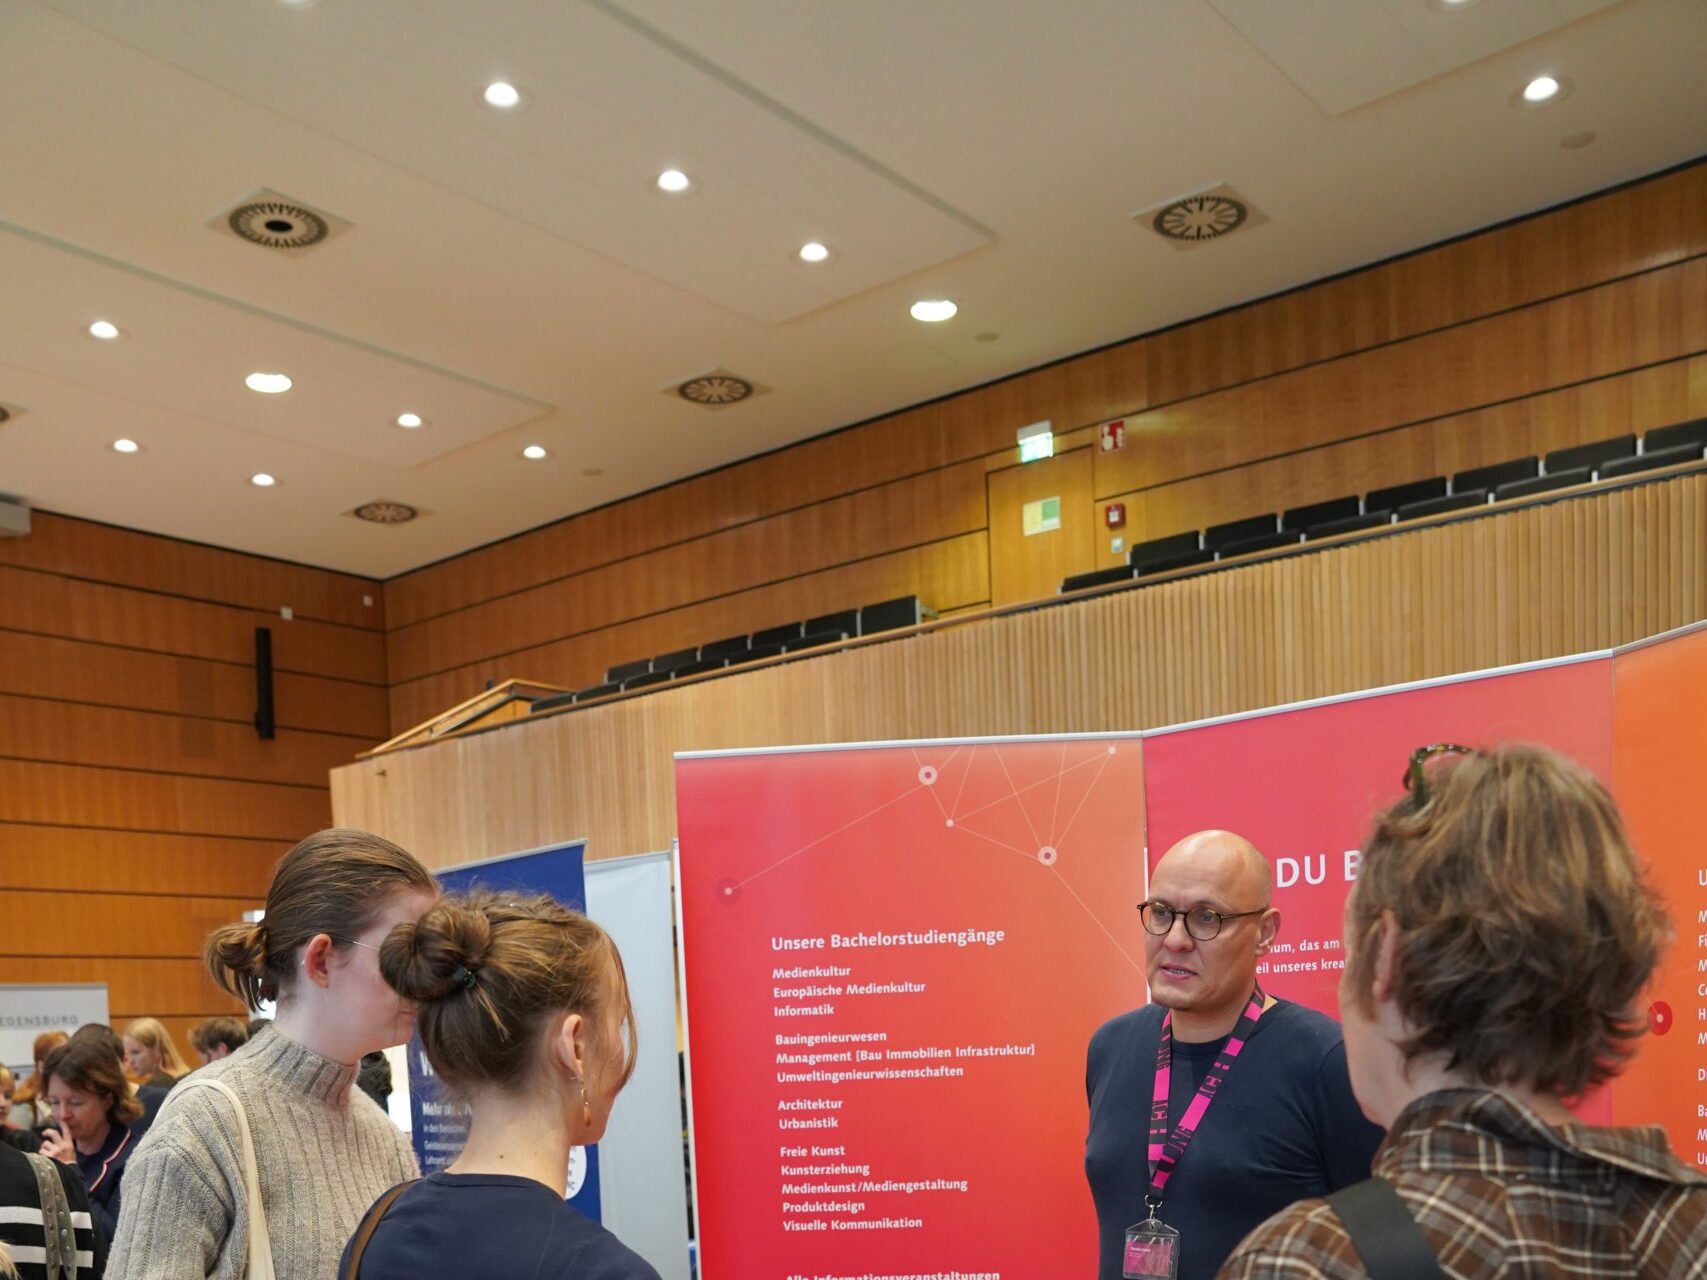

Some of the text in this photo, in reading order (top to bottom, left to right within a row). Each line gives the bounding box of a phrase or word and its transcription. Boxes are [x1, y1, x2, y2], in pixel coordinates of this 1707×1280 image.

[1277, 854, 1325, 887] DU
[772, 929, 1004, 950] Unsere Bachelorstudiengänge
[1300, 940, 1319, 951] das
[1323, 940, 1339, 949] am
[773, 966, 851, 978] Medienkultur
[1274, 962, 1317, 972] unseres
[774, 982, 926, 999] Europäische Medienkultur
[775, 1004, 834, 1016] Informatik
[776, 1032, 886, 1047] Bauingenieurwesen
[776, 1044, 1035, 1065] Management [Bau Immobilien Infrastruktur]
[777, 1068, 963, 1083] Umweltingenieurwissenschaften
[778, 1099, 842, 1110] Architektur
[779, 1117, 838, 1129] Urbanistik
[781, 1146, 845, 1157] Freie Kunst
[781, 1163, 869, 1176] Kunsterziehung
[782, 1180, 967, 1194] Medienkunst/Mediengestaltung
[783, 1201, 865, 1214] Produktdesign
[783, 1217, 922, 1230] Visuelle Kommunikation
